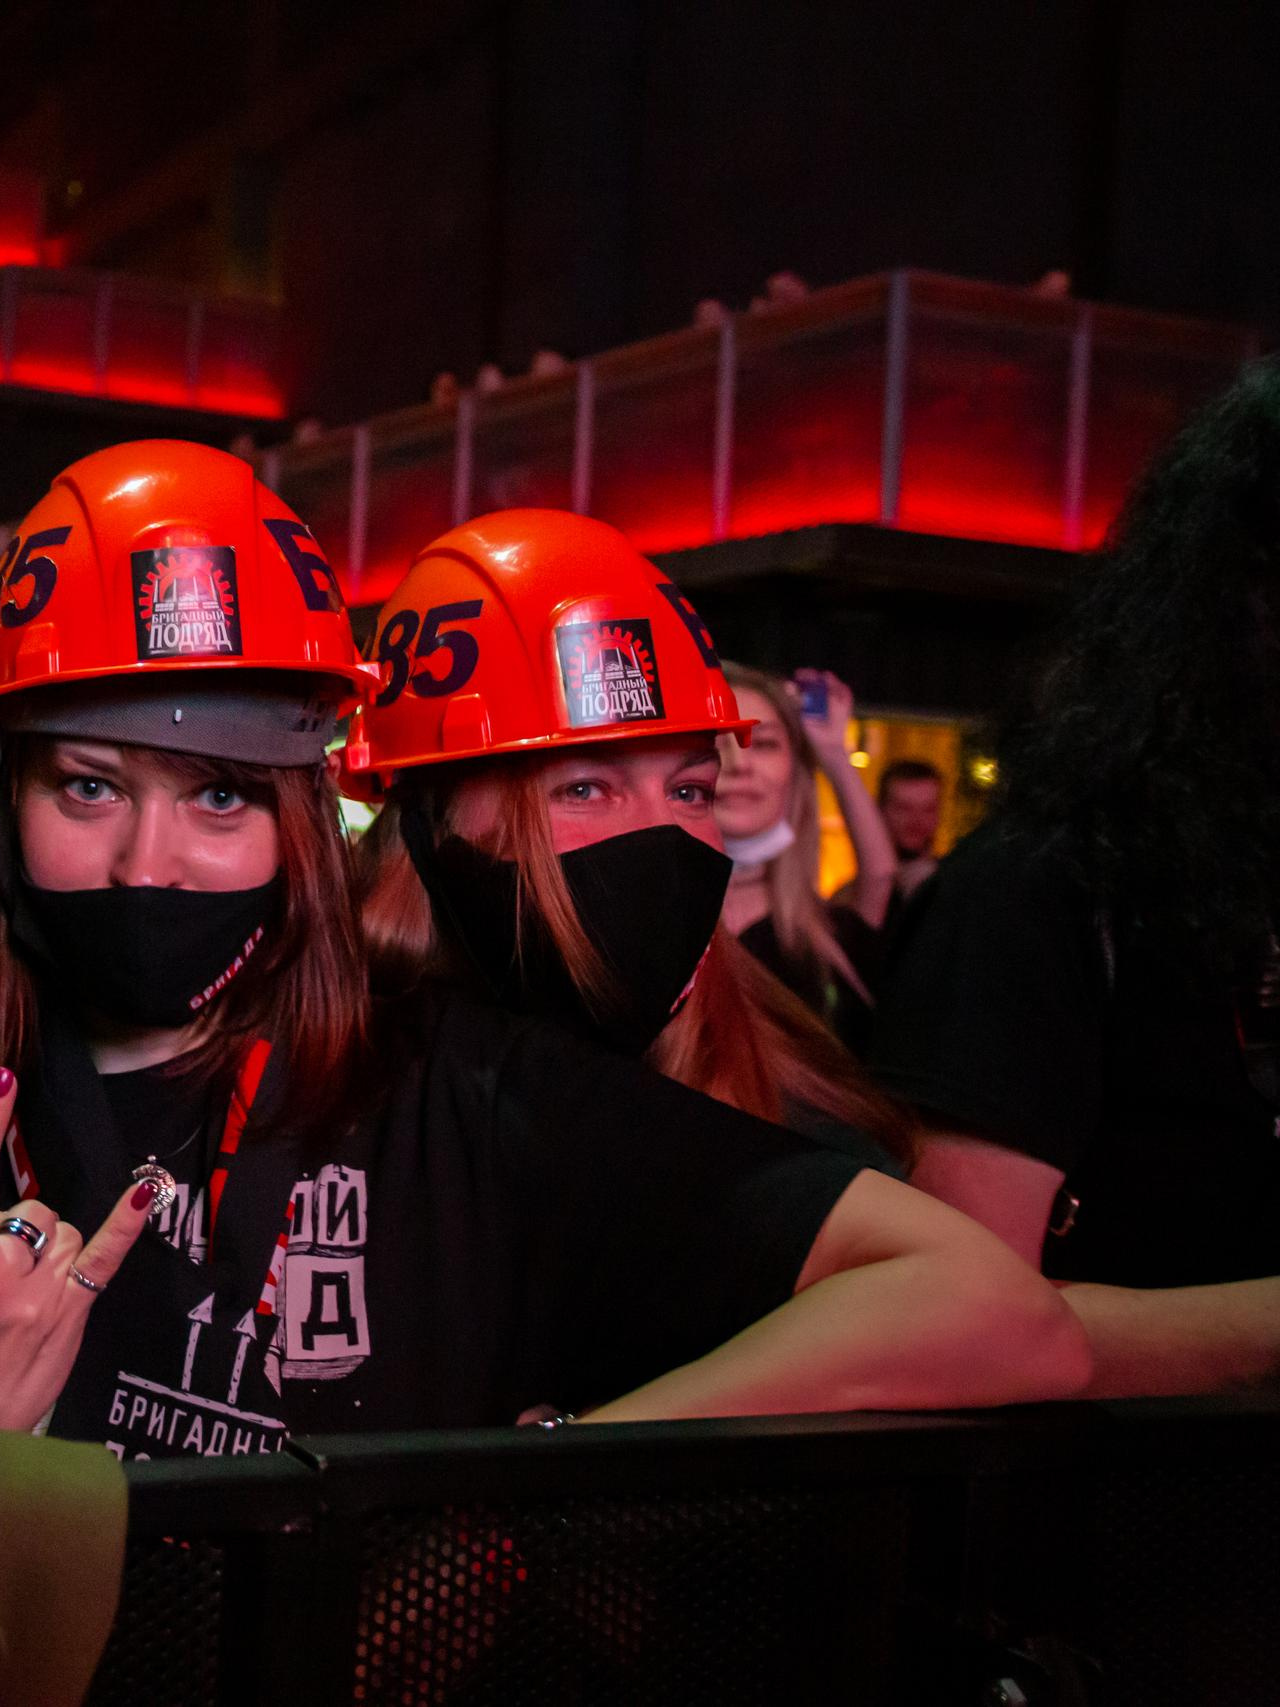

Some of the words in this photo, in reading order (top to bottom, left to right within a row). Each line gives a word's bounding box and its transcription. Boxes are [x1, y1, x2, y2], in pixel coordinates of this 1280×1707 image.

[152, 608, 225, 625] БРИГАДНЫЙ
[148, 621, 233, 653] ПОДРЯД
[581, 677, 648, 693] БРИГАДНЫЙ
[581, 687, 657, 719] ПОДРЯД
[107, 1388, 286, 1457] БРИГАДНЫ
